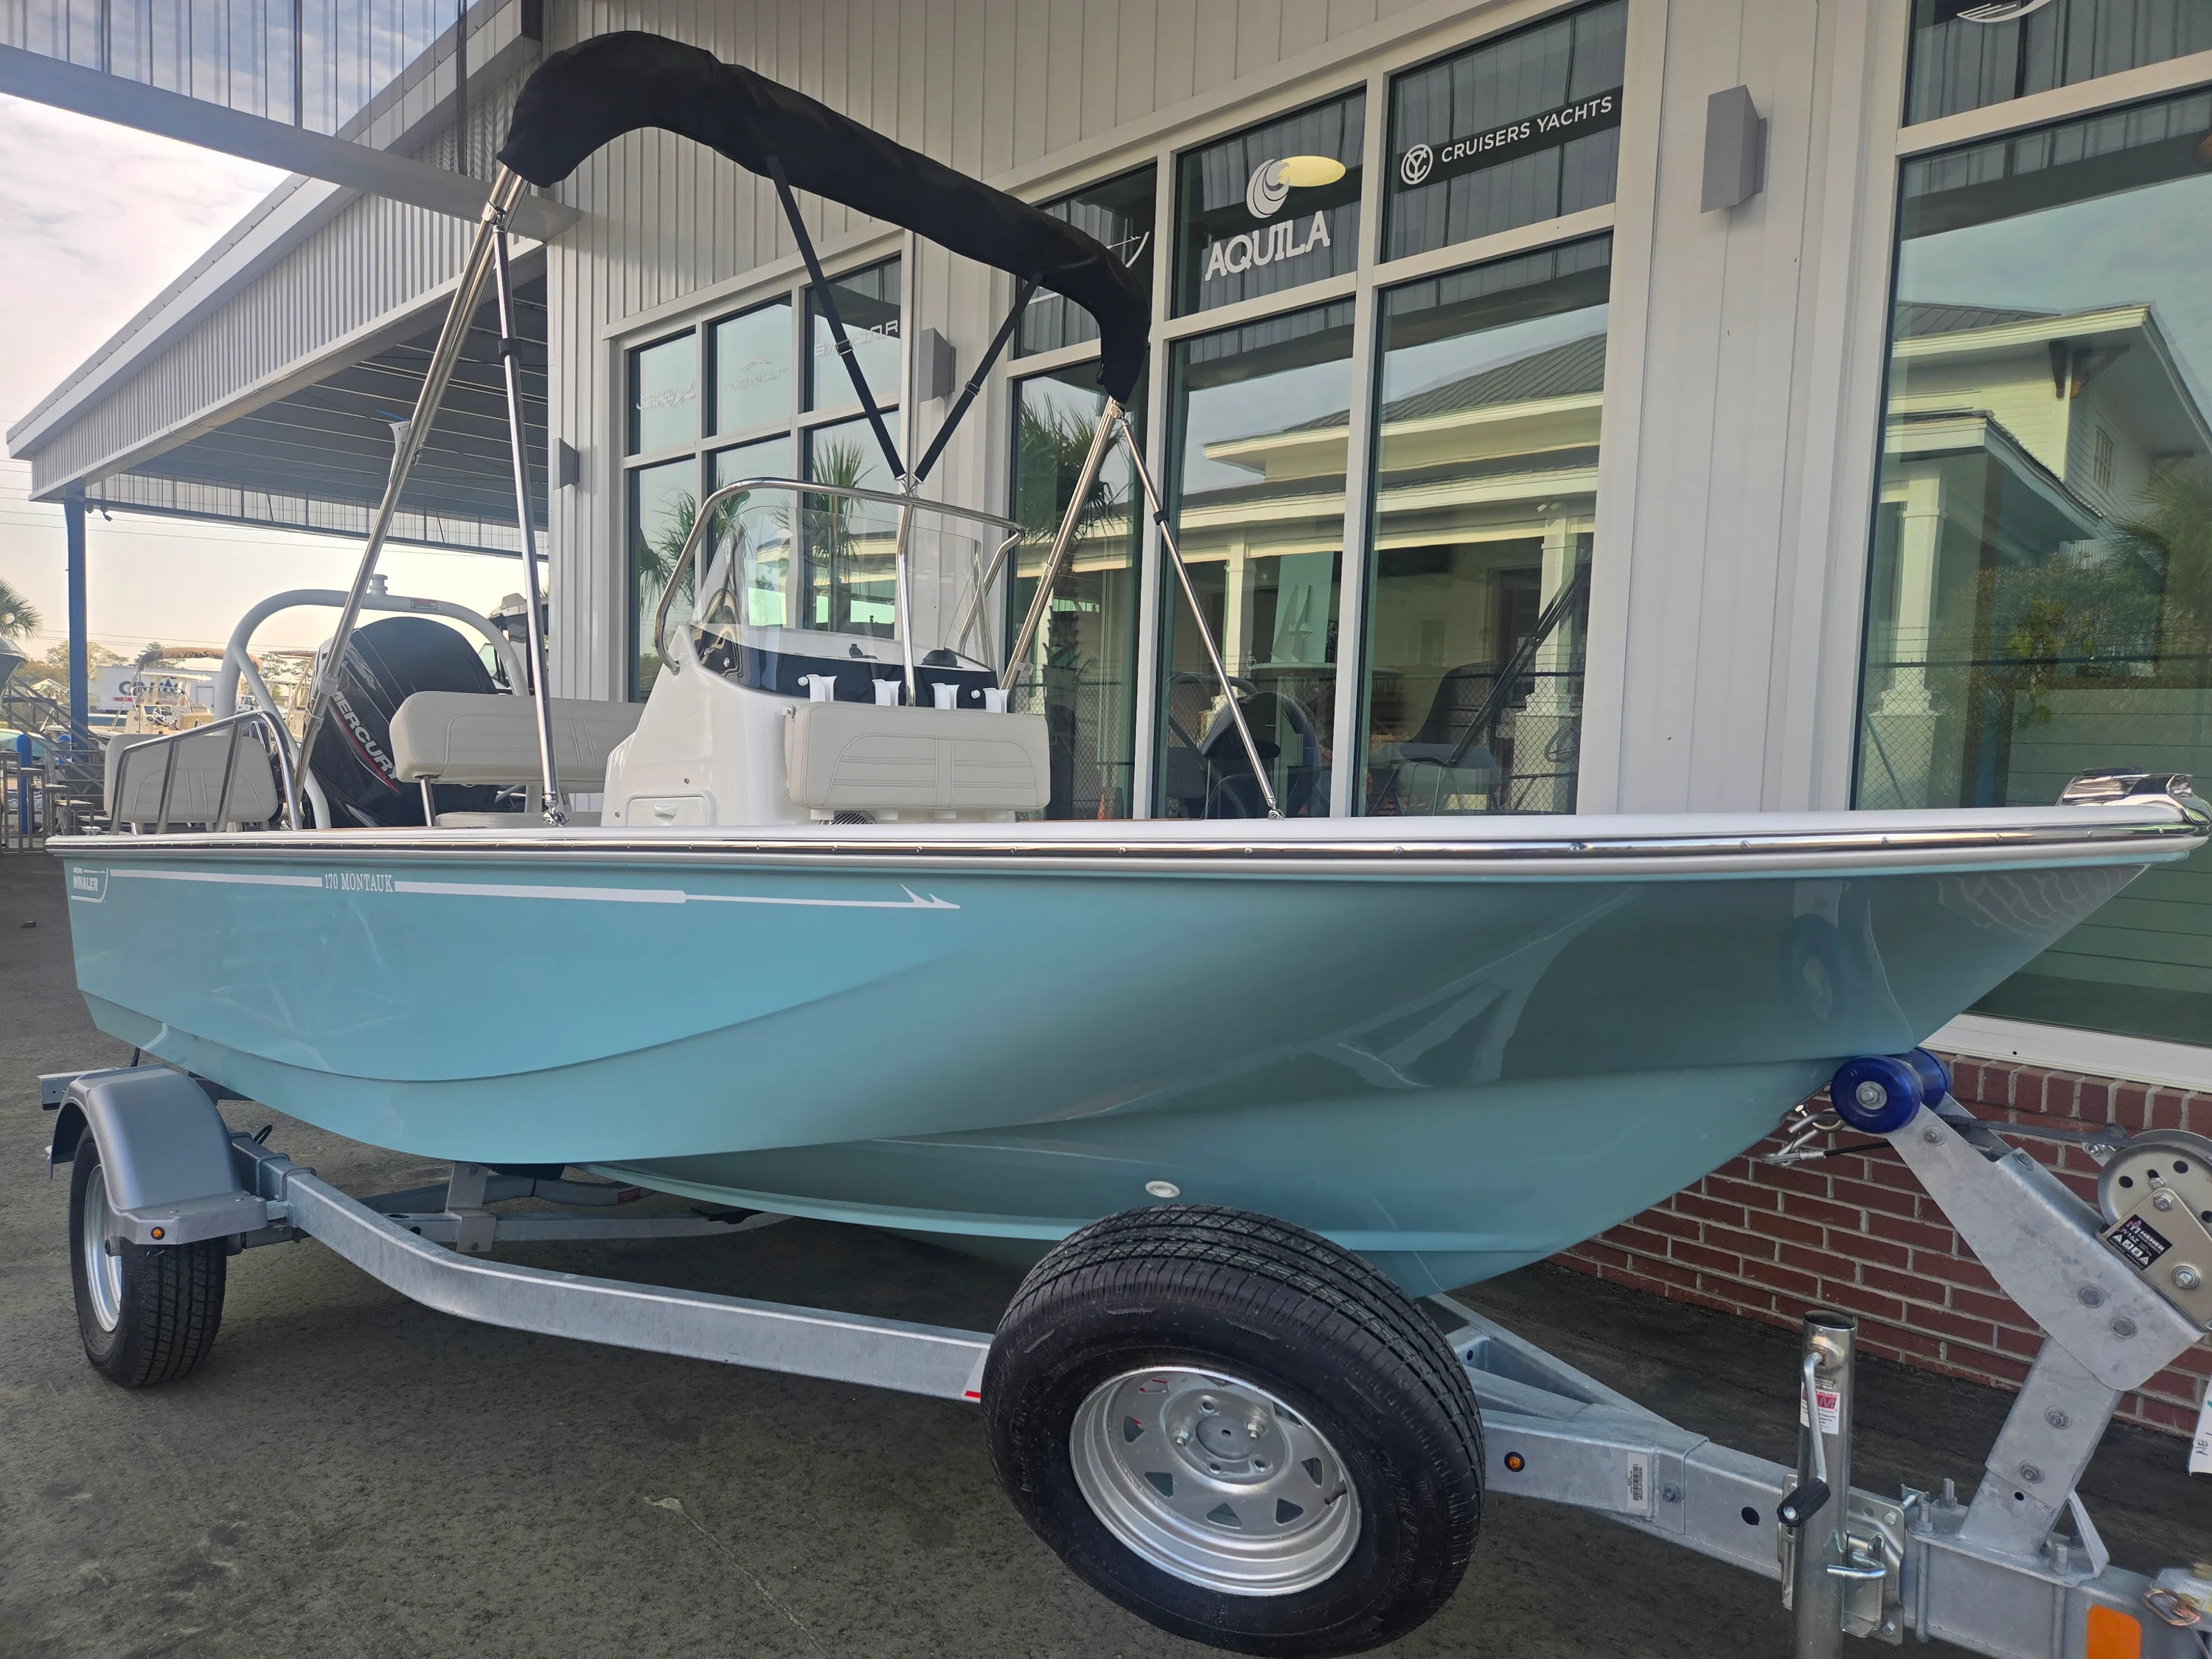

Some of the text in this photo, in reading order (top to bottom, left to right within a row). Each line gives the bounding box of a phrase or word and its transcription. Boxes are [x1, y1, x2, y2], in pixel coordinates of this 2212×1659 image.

[1441, 96, 1613, 163] CRUISERS YACHTS
[1205, 210, 1331, 282] AQUILA
[73, 875, 98, 891] WHALER
[324, 873, 393, 892] 170 MONTAUK
